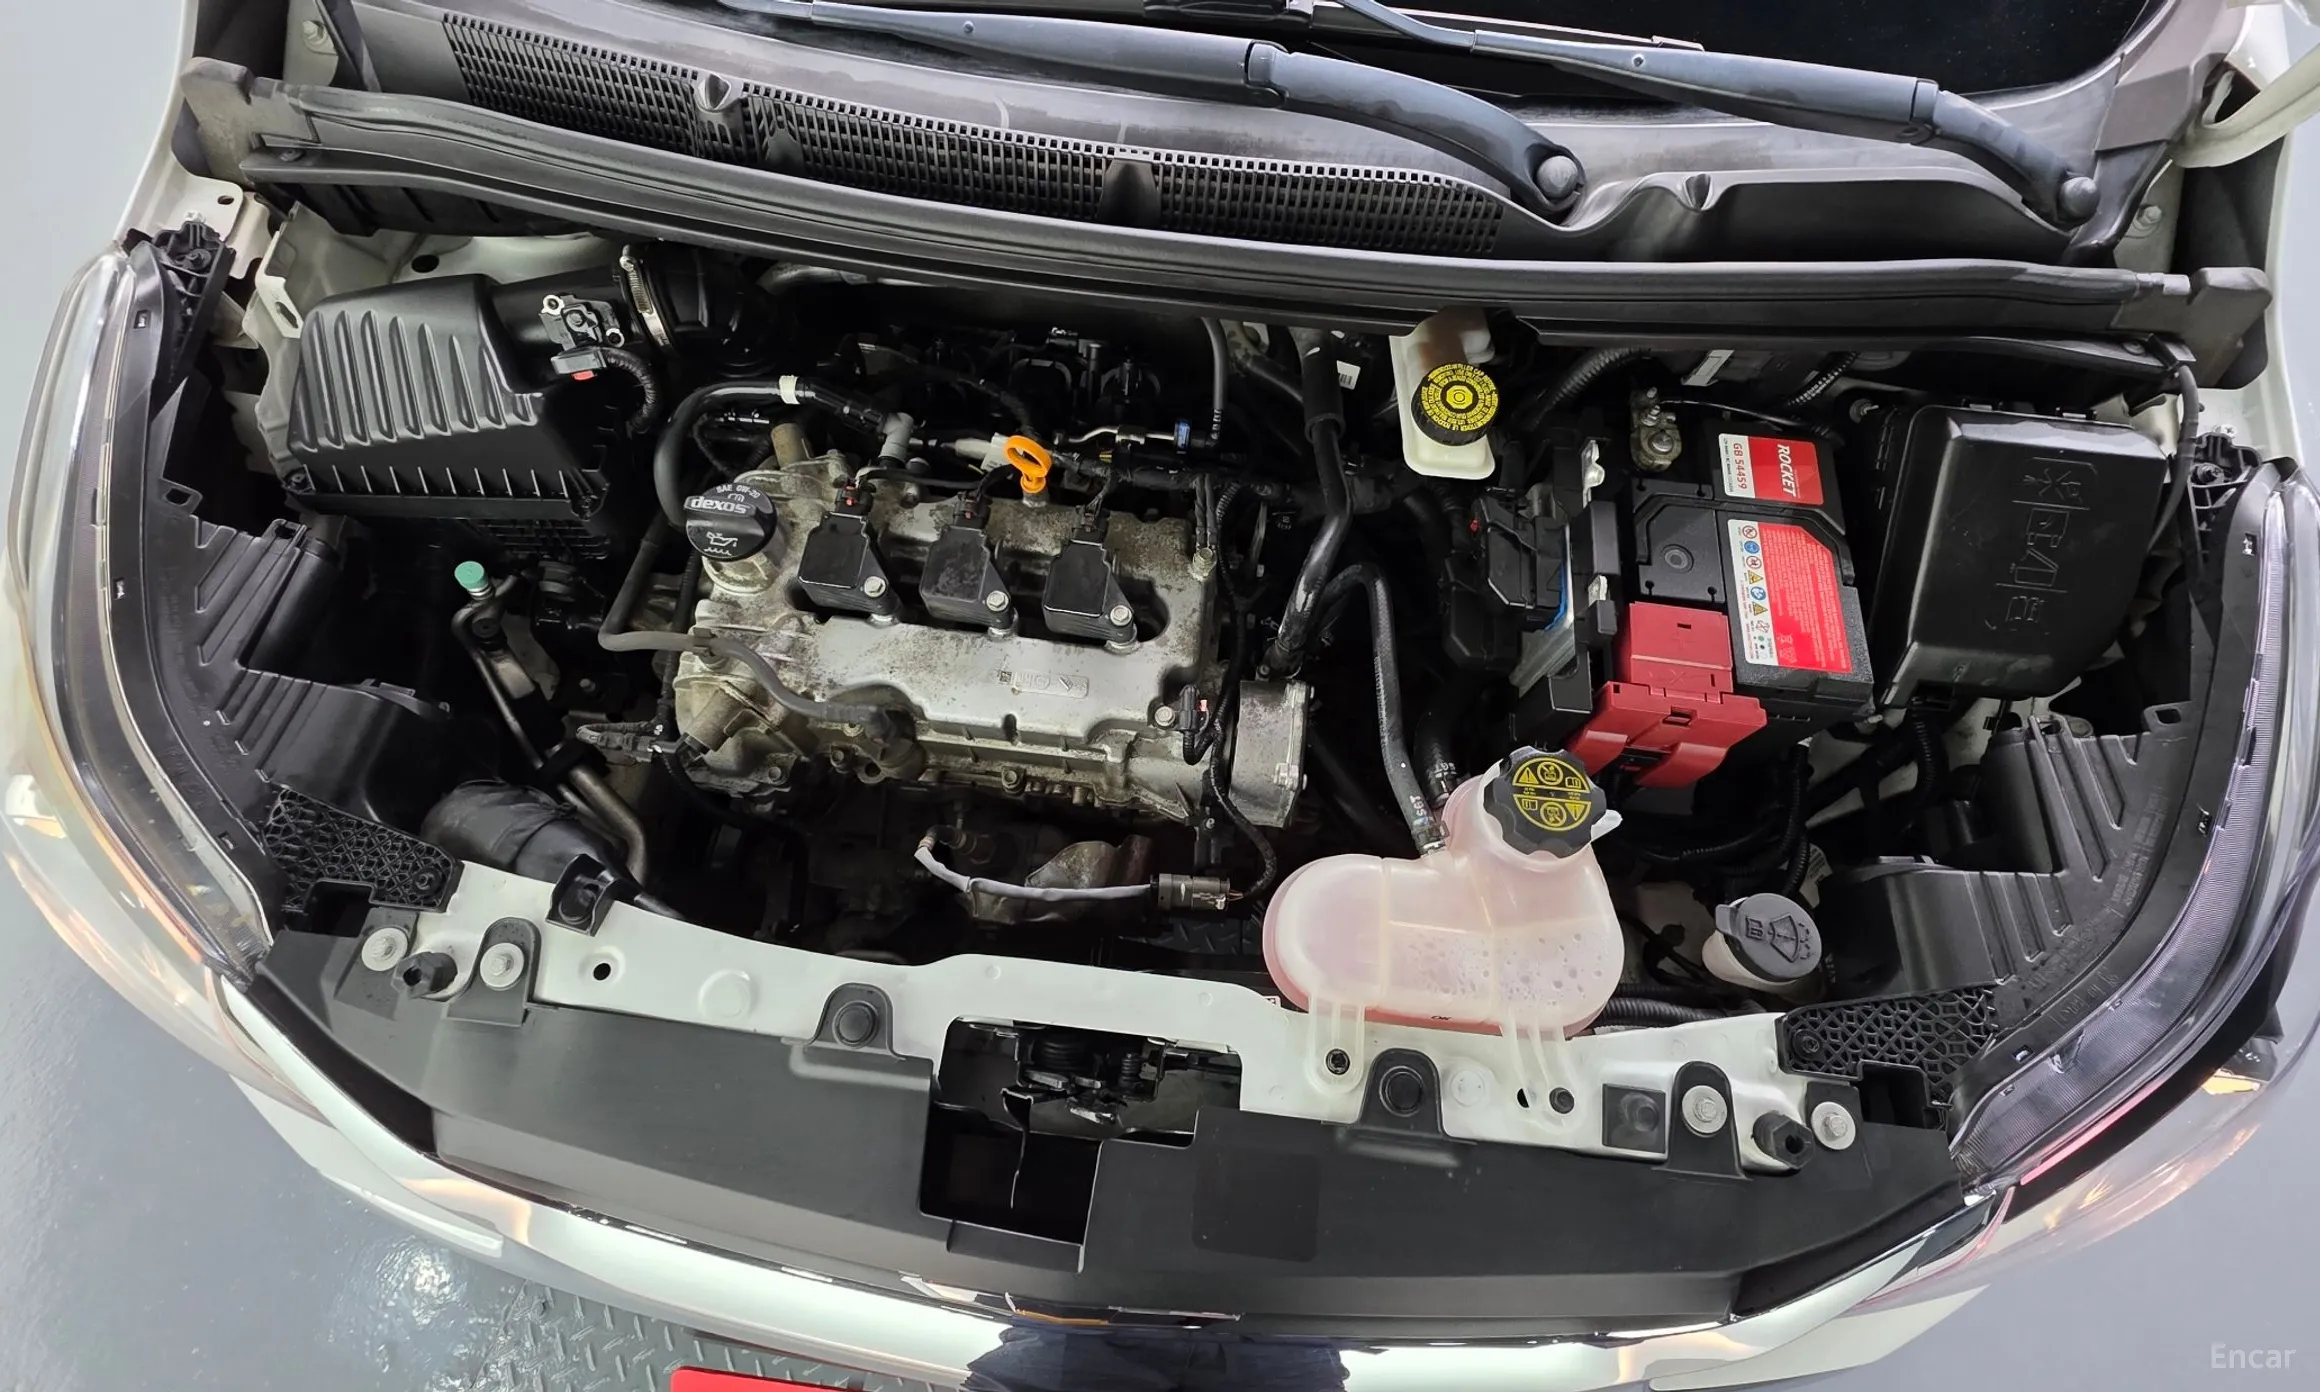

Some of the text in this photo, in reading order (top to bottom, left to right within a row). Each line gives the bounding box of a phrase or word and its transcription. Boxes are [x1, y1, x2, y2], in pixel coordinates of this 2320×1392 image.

[1733, 443, 1747, 490] GB 54459
[1777, 443, 1797, 498] ROCKET
[690, 495, 751, 514] dexos
[715, 484, 761, 498] SAE 0W-20
